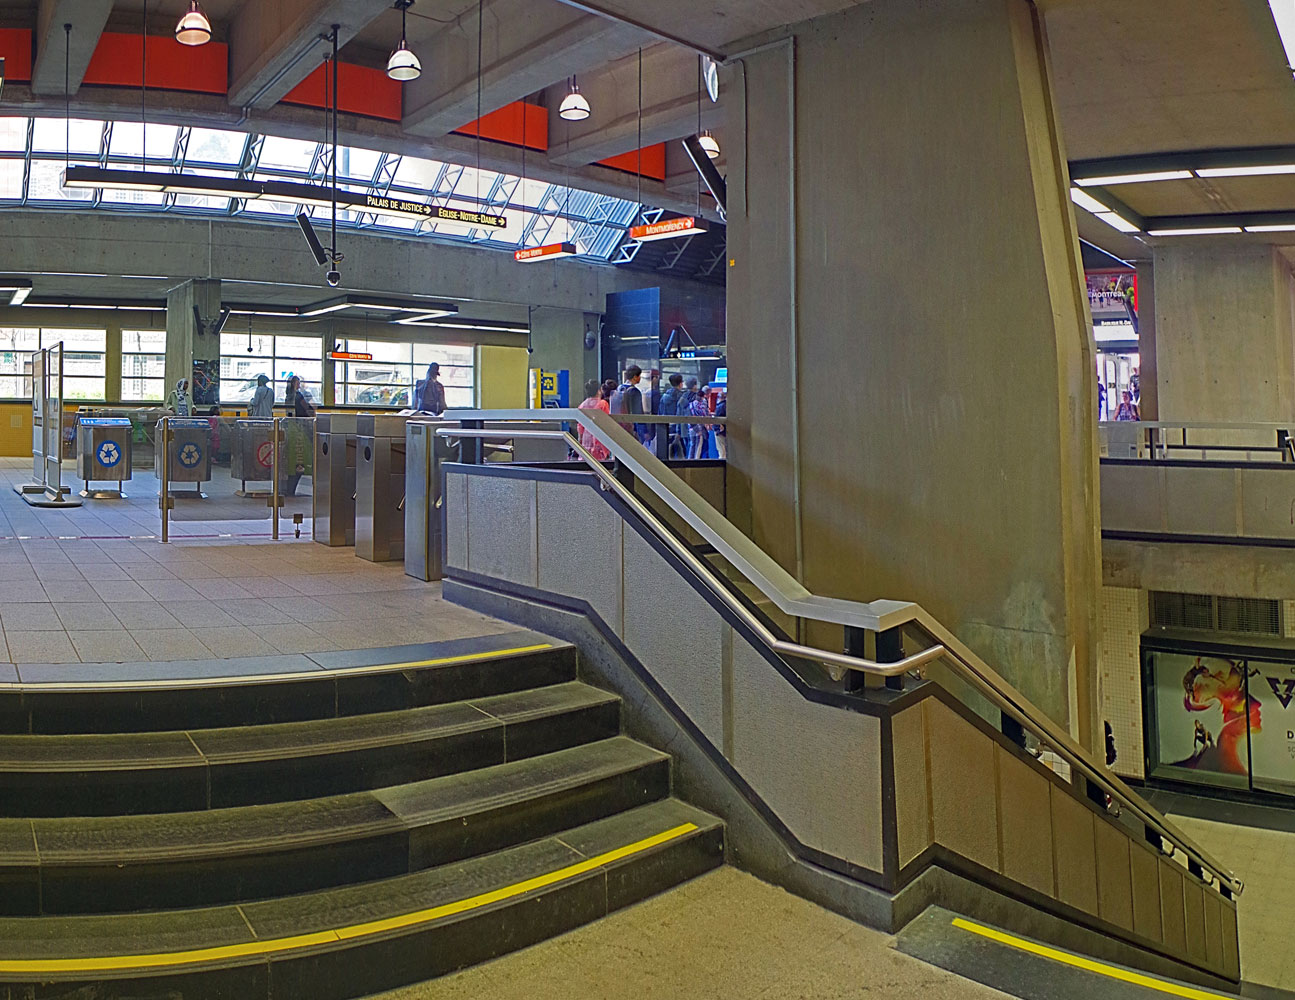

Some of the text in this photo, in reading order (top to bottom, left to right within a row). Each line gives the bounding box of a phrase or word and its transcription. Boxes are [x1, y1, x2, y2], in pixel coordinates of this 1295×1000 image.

[367, 196, 423, 213] PALAIS DE JUSTICE
[646, 221, 685, 235] MONTMORENCY
